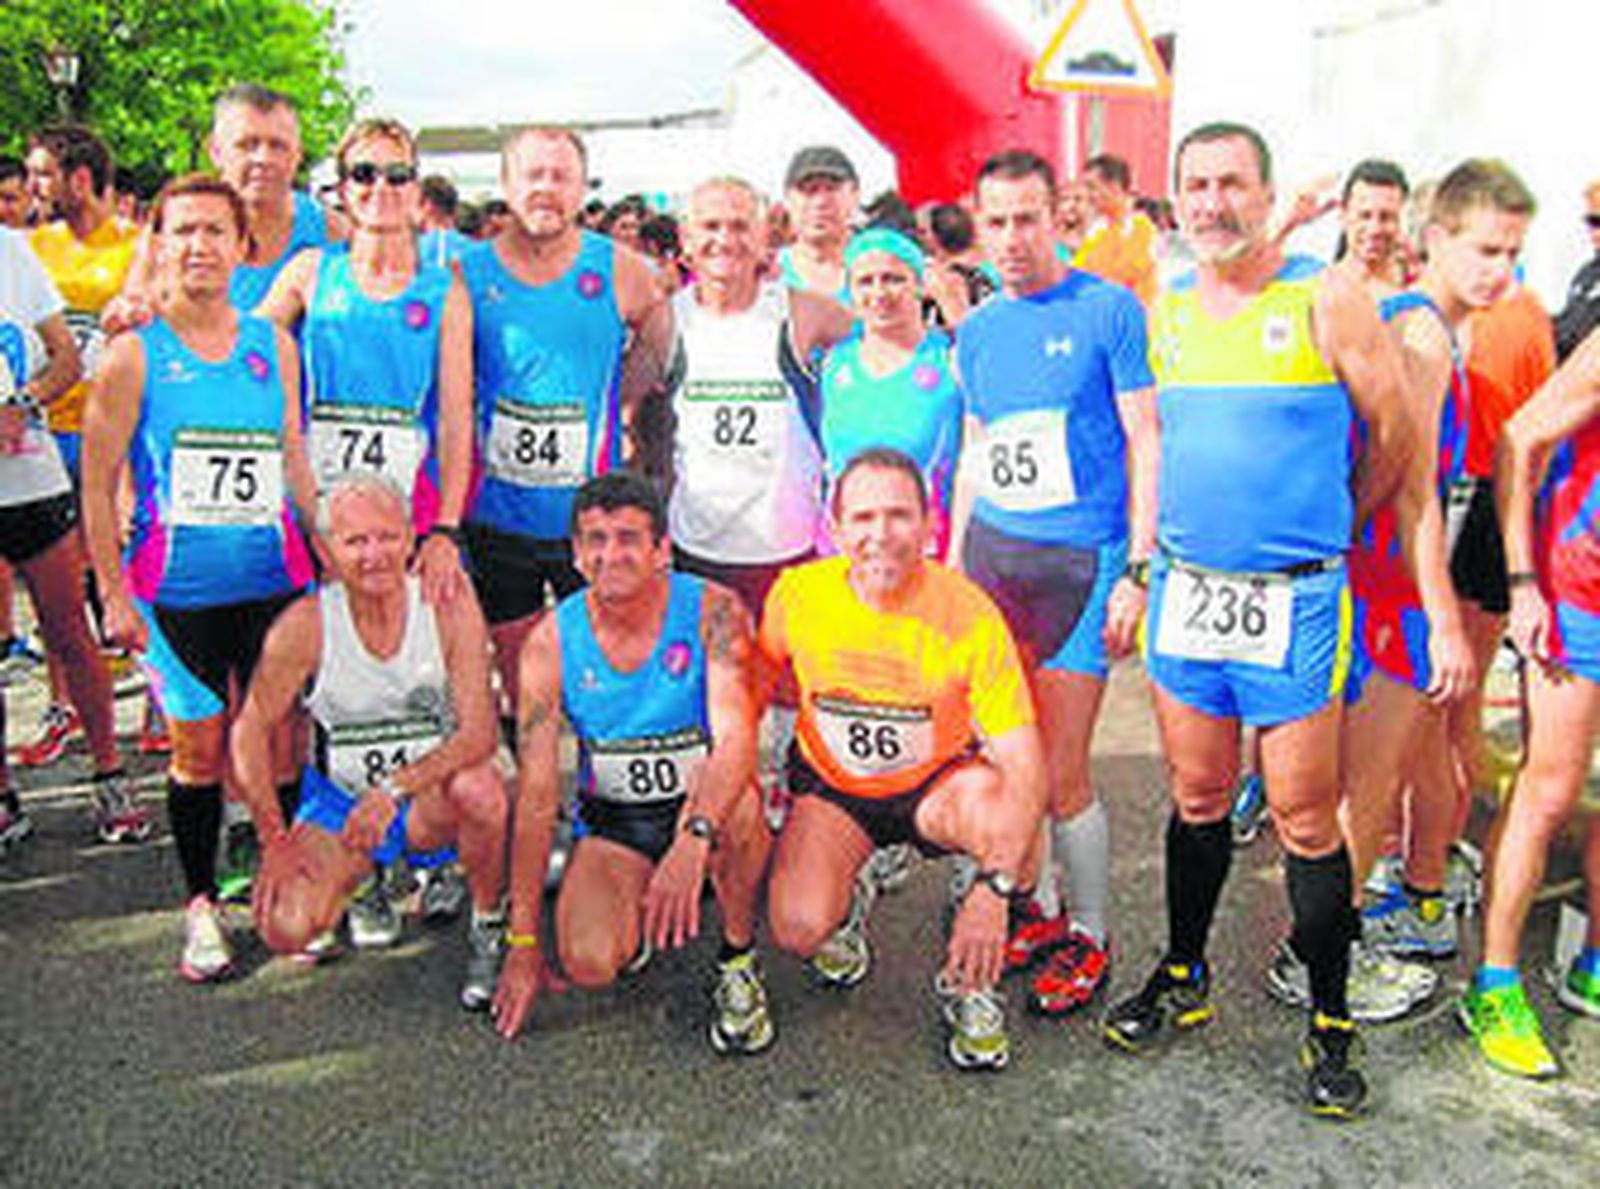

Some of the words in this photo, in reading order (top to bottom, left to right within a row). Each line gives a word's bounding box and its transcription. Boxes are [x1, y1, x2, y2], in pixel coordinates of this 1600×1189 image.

[713, 405, 759, 446] 82
[338, 429, 386, 473] 74
[514, 427, 561, 467] 84
[991, 442, 1038, 488] 85
[207, 456, 259, 502] 75
[1183, 573, 1267, 638] 236
[848, 722, 901, 763] 86
[628, 757, 678, 797] 80
